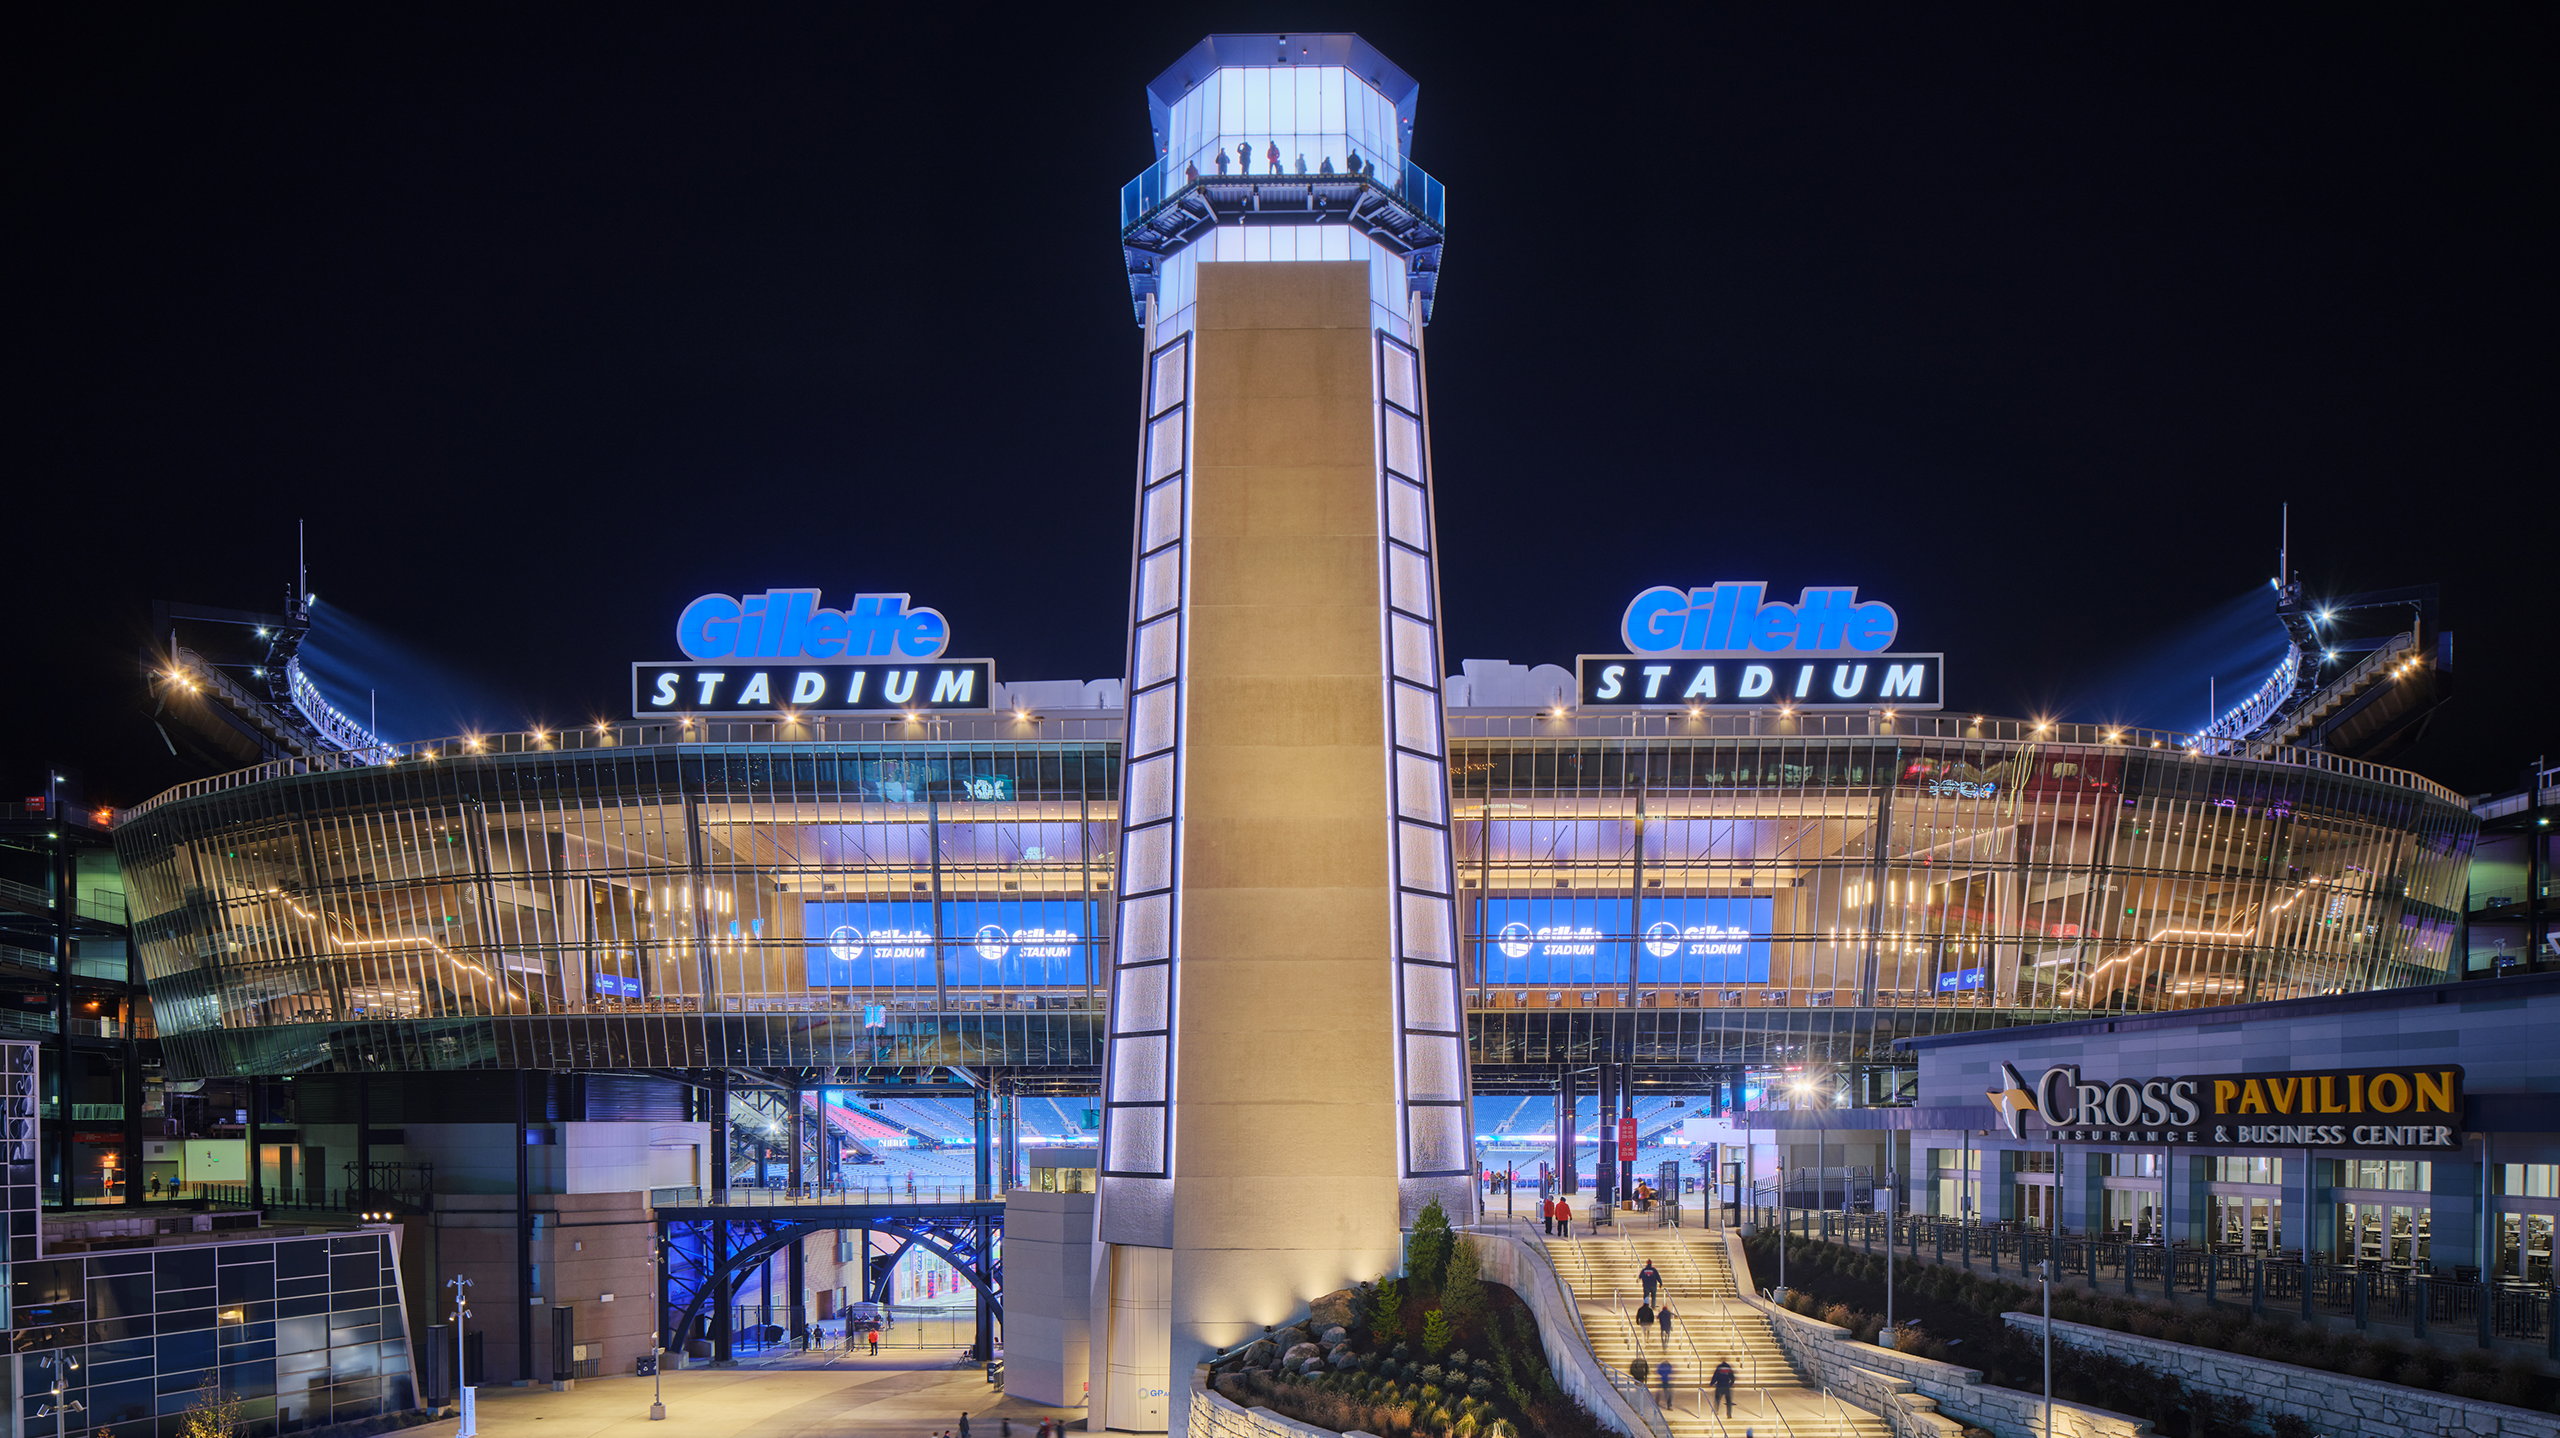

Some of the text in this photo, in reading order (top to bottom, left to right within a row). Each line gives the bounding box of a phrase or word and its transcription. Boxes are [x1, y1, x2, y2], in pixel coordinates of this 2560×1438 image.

[679, 592, 945, 659] Gillette
[1625, 584, 1896, 653] Gillette
[651, 669, 975, 706] STADIUM
[1596, 664, 1925, 699] STADIUM
[873, 947, 926, 958] STADIUM
[1019, 946, 1071, 958] STADIUM
[1542, 944, 1596, 955] STADIUM
[1689, 944, 1743, 955] STADIUM
[2213, 1071, 2456, 1115] PAVILION
[2045, 1129, 2198, 1143] INSURANCE
[2213, 1124, 2454, 1146] & BUSINESS CENTER
